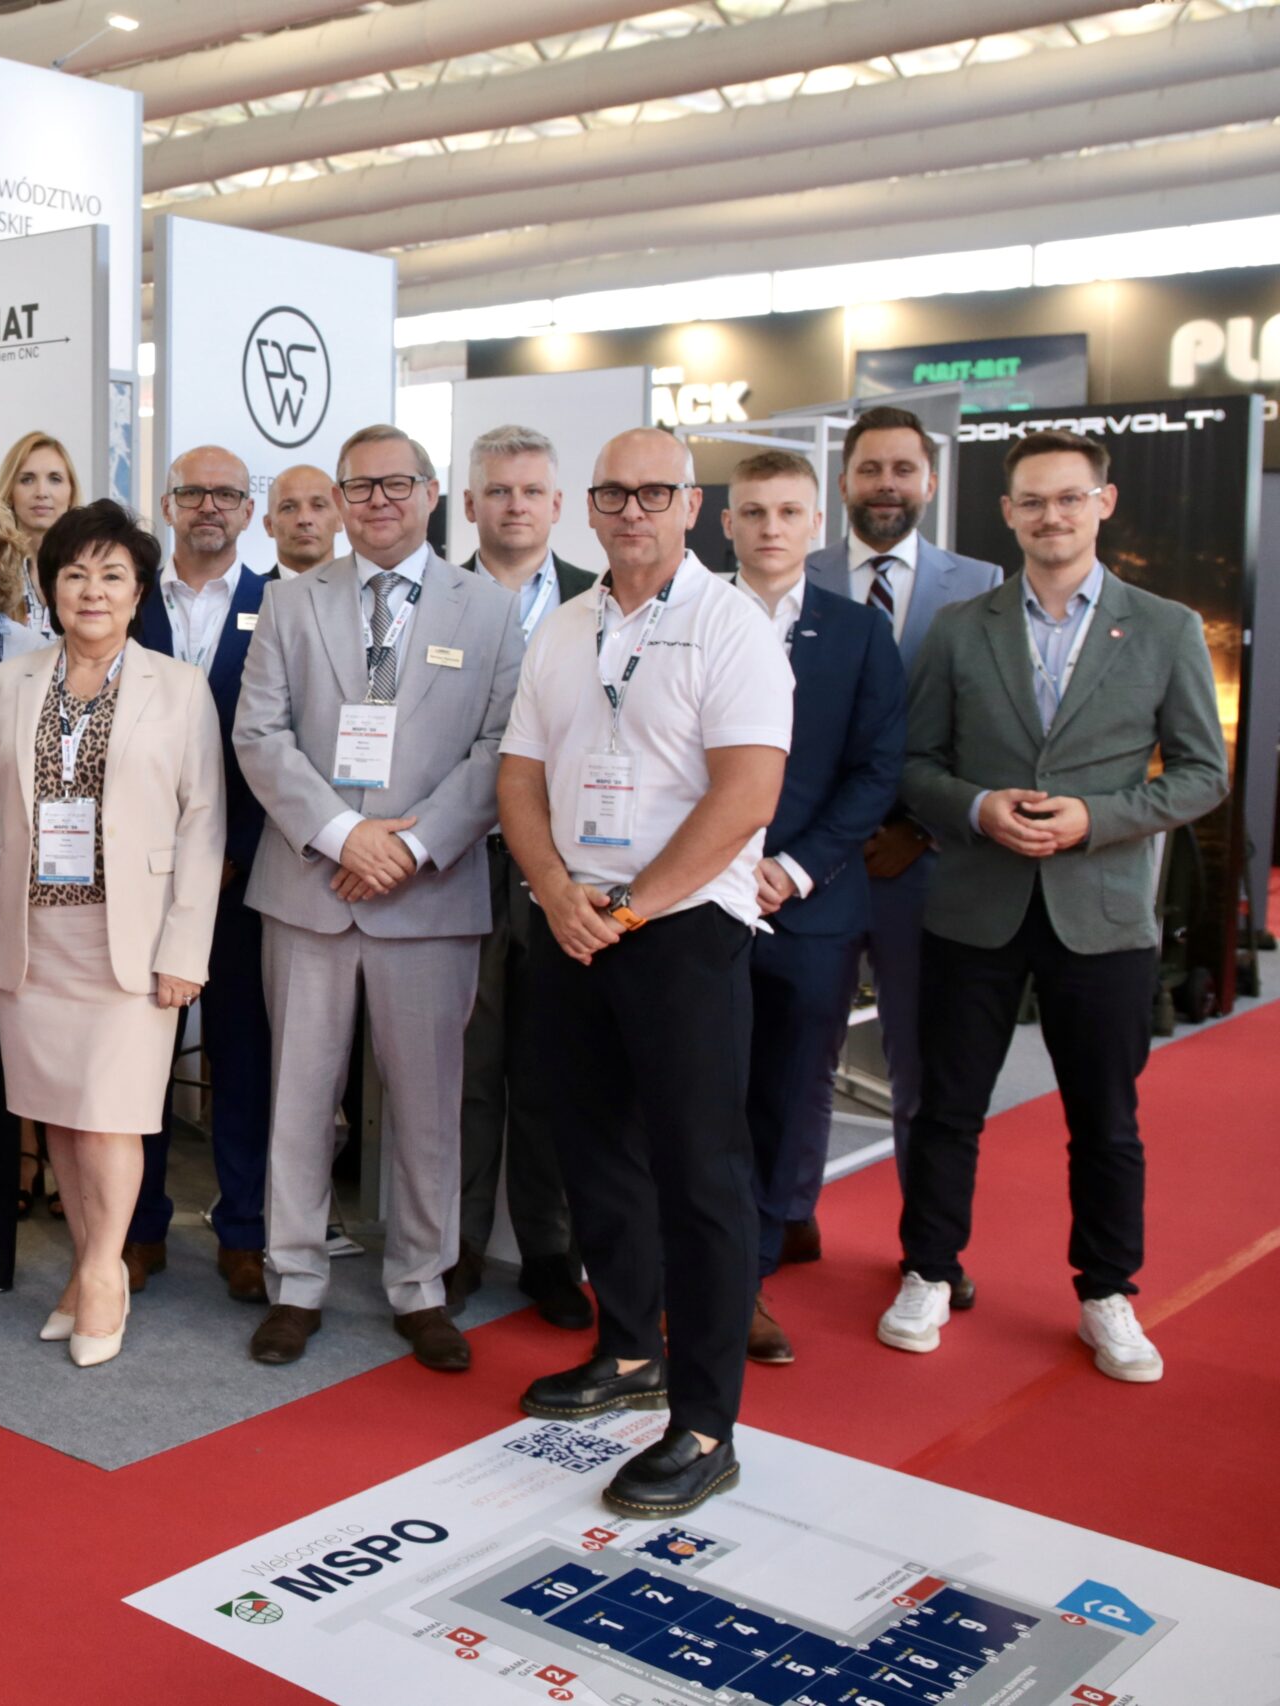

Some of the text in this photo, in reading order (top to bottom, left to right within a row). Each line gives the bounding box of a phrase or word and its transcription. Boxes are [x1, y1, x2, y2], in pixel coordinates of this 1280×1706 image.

[18, 346, 40, 360] CNC
[592, 1530, 610, 1540] 4
[240, 1522, 366, 1578] Welcome to
[270, 1518, 449, 1602] MSPO
[543, 1582, 579, 1600] 10
[644, 1590, 674, 1604] 2
[1098, 1604, 1132, 1622] P
[412, 1620, 442, 1638] BRAMA
[599, 1618, 625, 1630] 1
[732, 1622, 759, 1636] 4
[958, 1618, 988, 1632] 9
[430, 1626, 452, 1640] GATE
[456, 1632, 476, 1642] 3
[682, 1652, 712, 1666] 3
[908, 1654, 940, 1670] 8
[498, 1658, 528, 1676] BRAMA
[518, 1663, 542, 1678] GATE
[785, 1661, 816, 1677] 5
[546, 1670, 566, 1682] 2
[882, 1672, 914, 1688] 7
[1082, 1690, 1104, 1702] 6
